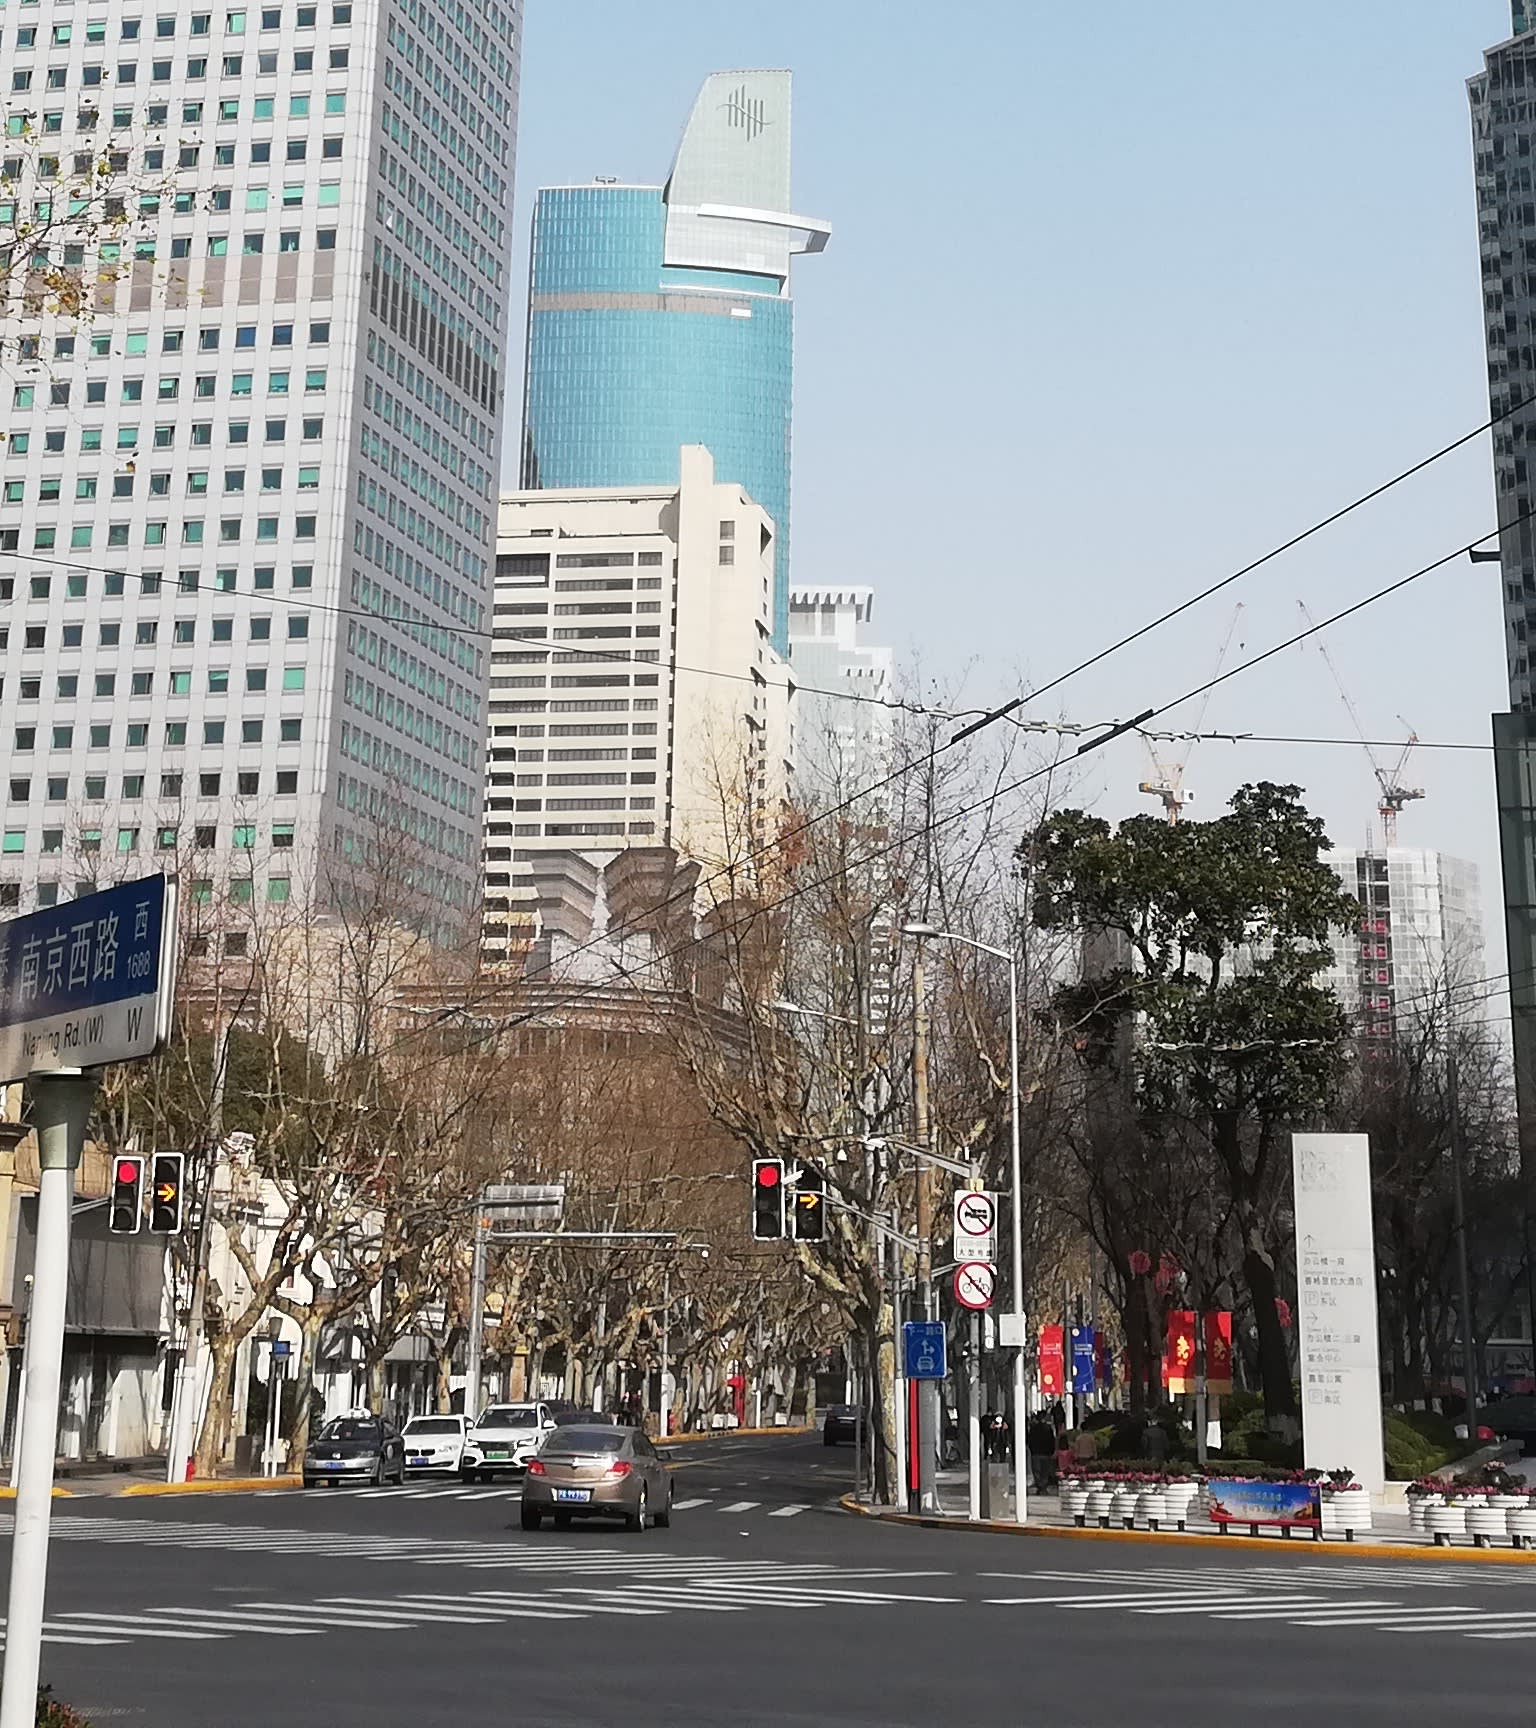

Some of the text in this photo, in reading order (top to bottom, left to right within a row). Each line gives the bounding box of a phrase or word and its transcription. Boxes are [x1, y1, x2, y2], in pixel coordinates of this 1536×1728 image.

[133, 900, 151, 942] 西
[18, 909, 120, 1003] 南京西路
[127, 949, 152, 980] 1688
[22, 1013, 104, 1060] Nanjing Rd. (W)
[126, 1006, 145, 1043] W
